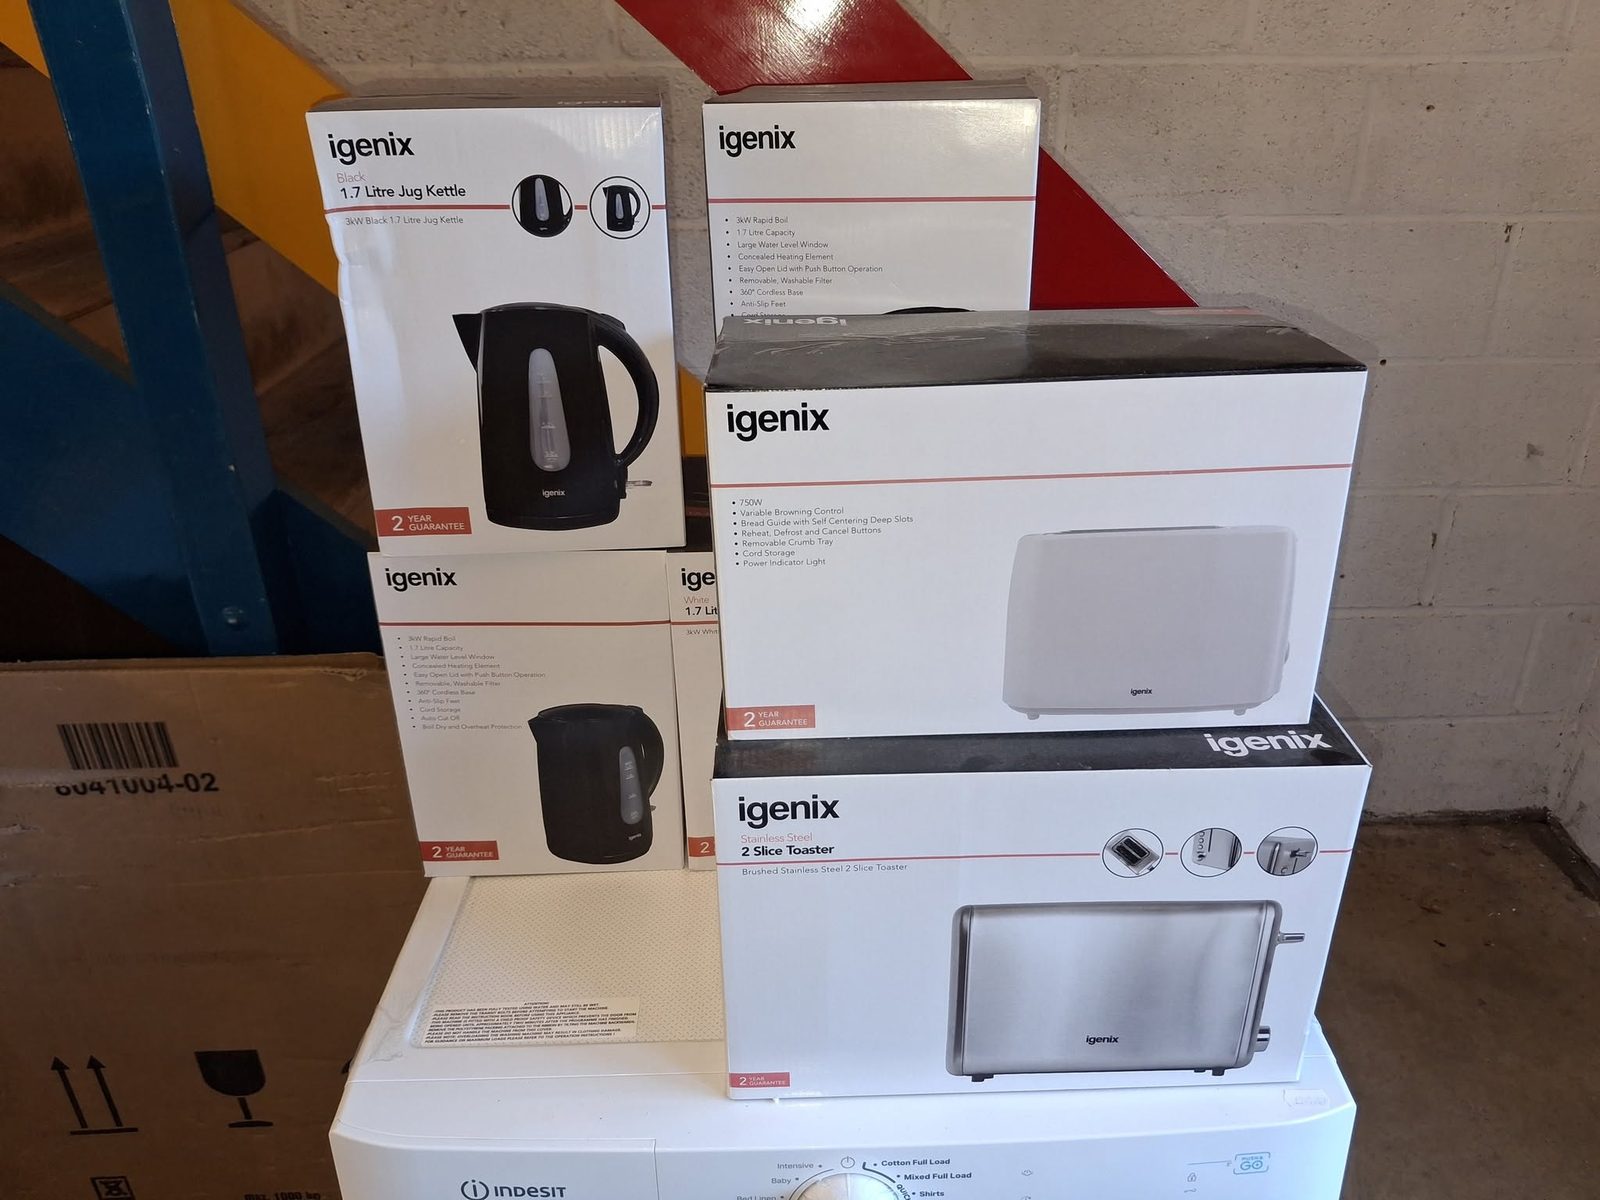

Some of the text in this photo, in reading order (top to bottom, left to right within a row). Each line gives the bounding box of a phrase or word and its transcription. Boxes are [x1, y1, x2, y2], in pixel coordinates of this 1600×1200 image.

[719, 125, 796, 157] igenix
[328, 132, 414, 165] igenix
[337, 171, 366, 183] Black
[340, 184, 466, 200] 1.7 Litre Jug Kettle
[345, 216, 363, 225] 3kW
[365, 216, 388, 224] Black
[423, 216, 438, 225] Jug
[753, 217, 773, 225] Rapid
[766, 229, 795, 238] Capacity
[738, 242, 756, 250] Large
[776, 254, 804, 262] Heating
[739, 265, 755, 274] Easy
[755, 265, 776, 274] Open
[848, 265, 882, 274] Operation
[740, 277, 779, 285] Removable,
[744, 317, 846, 325] igenix
[727, 402, 829, 442] igenix
[775, 509, 812, 517] Browning
[392, 516, 404, 531] 2
[766, 518, 791, 526] Guide
[793, 517, 810, 525] with
[828, 517, 868, 525] Centering
[409, 523, 464, 531] GUARANTEE
[818, 538, 833, 546] Tray
[764, 549, 795, 558] Storage
[770, 558, 804, 566] Indicator
[806, 558, 825, 566] Light
[385, 568, 457, 592] igenix
[681, 568, 715, 592] ige
[686, 606, 717, 615] 1.7 Lit
[744, 712, 755, 727] 2
[1204, 730, 1332, 756] igenix
[739, 794, 839, 829] igenix
[741, 832, 812, 844] Stainless Steel
[432, 846, 442, 858] 2
[700, 842, 710, 853] 2
[742, 845, 834, 856] 2 Slice Toaster
[742, 867, 778, 875] Brushed
[1086, 1036, 1118, 1045] igenix
[740, 1077, 746, 1085] 2
[494, 1186, 566, 1198] INDESIT
